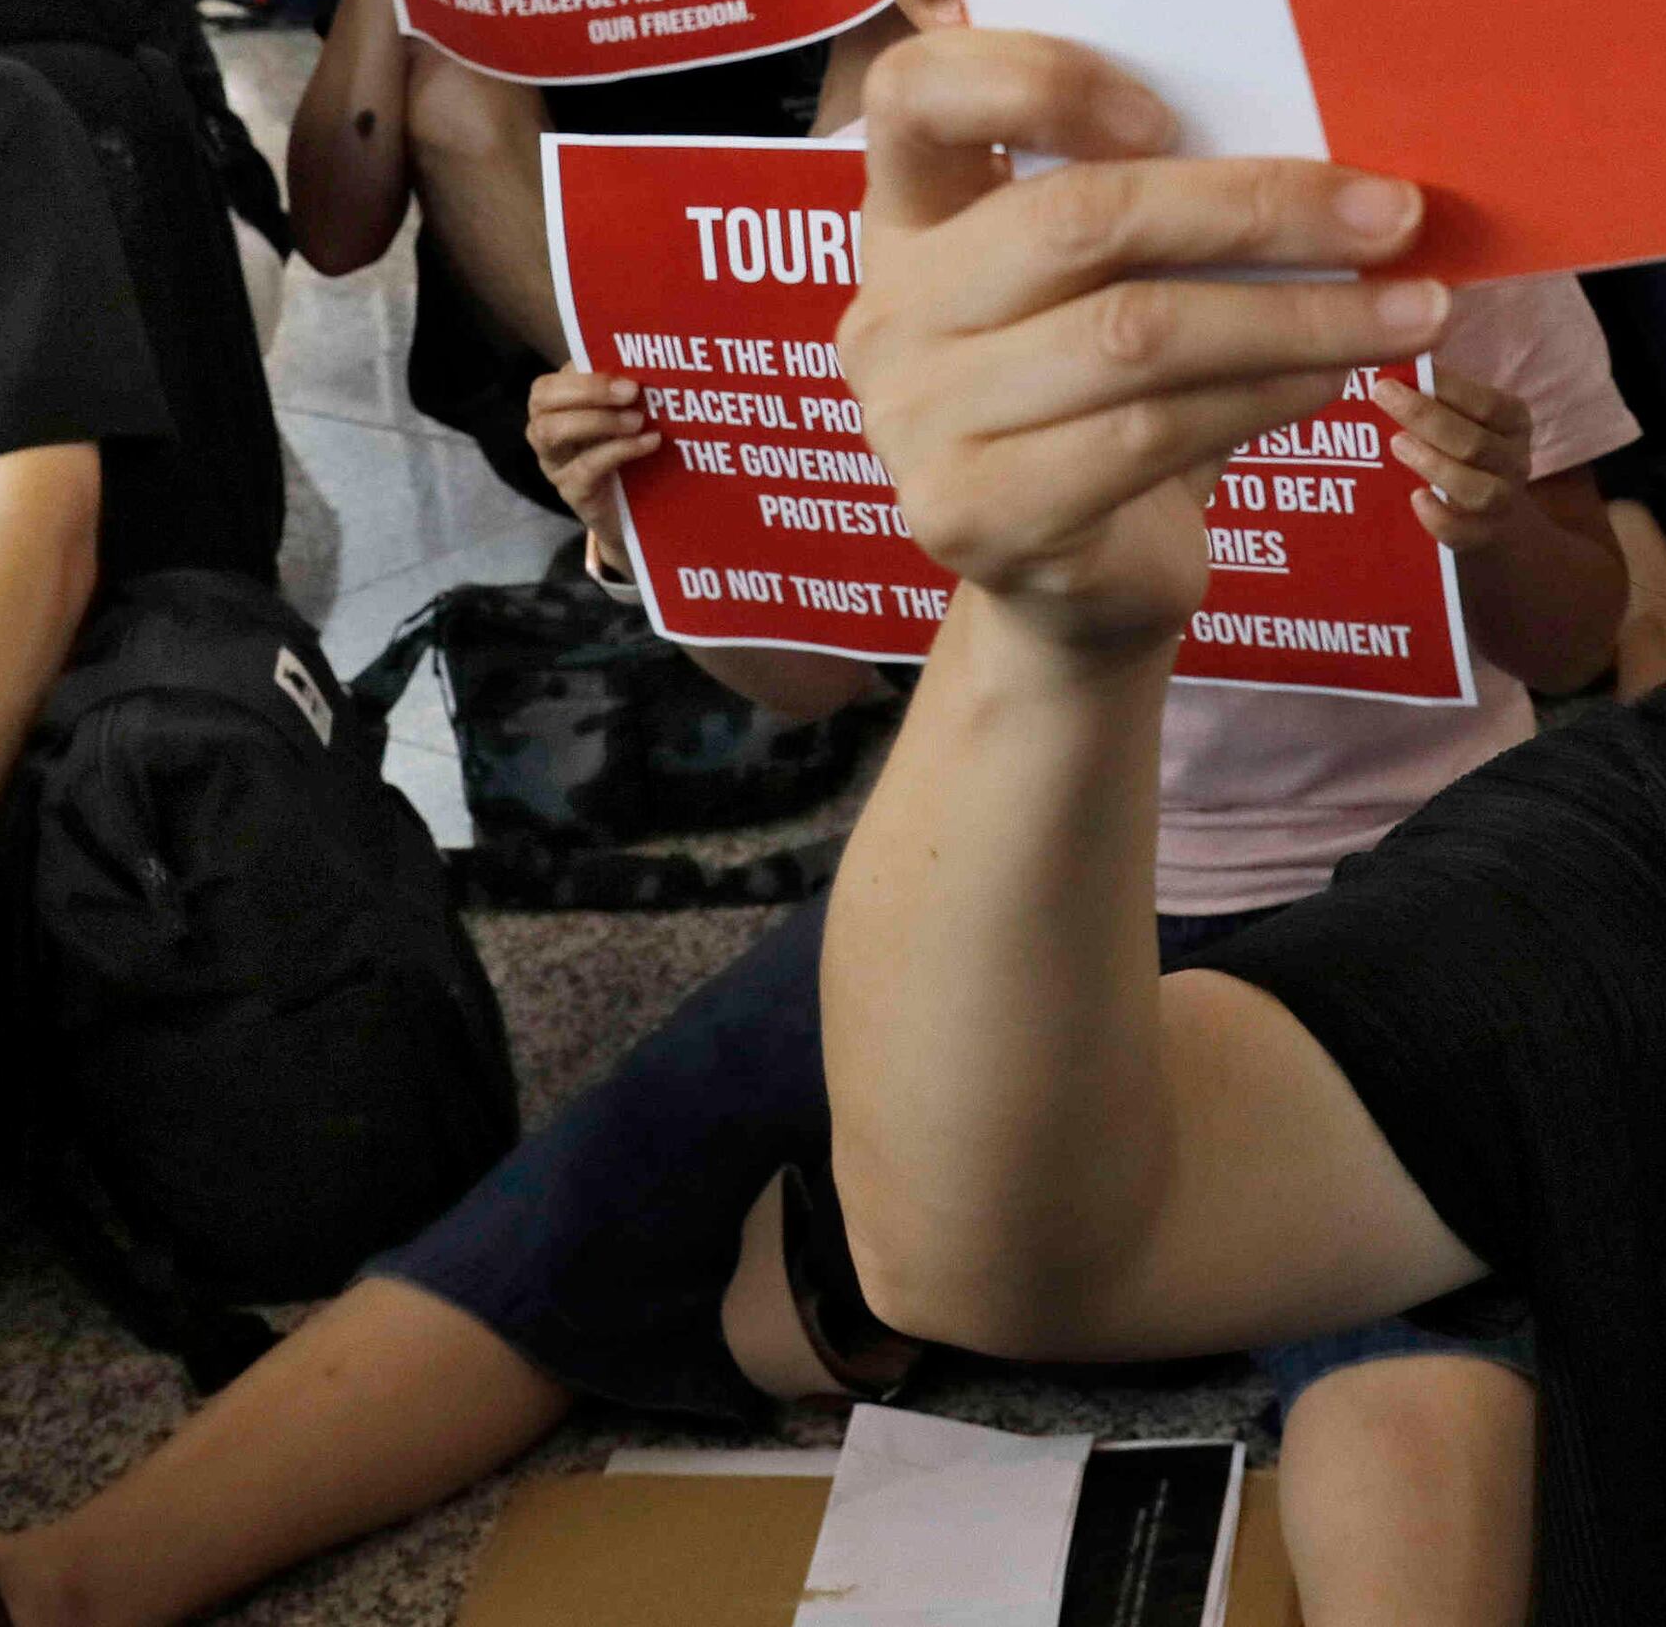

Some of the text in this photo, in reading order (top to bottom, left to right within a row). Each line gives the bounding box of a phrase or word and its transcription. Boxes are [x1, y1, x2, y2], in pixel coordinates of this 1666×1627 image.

[586, 15, 638, 45] OUR
[613, 332, 714, 373] WHILE
[714, 337, 780, 378] THE
[643, 386, 1381, 461] PEACEFUL PRO ISLAND
[674, 438, 737, 475] THE
[1221, 474, 1268, 511] TO
[1272, 476, 1358, 515] BEAT
[1206, 527, 1289, 566] RIES
[677, 567, 1413, 660] DO NOT TRUST THE GOVERNMENT
